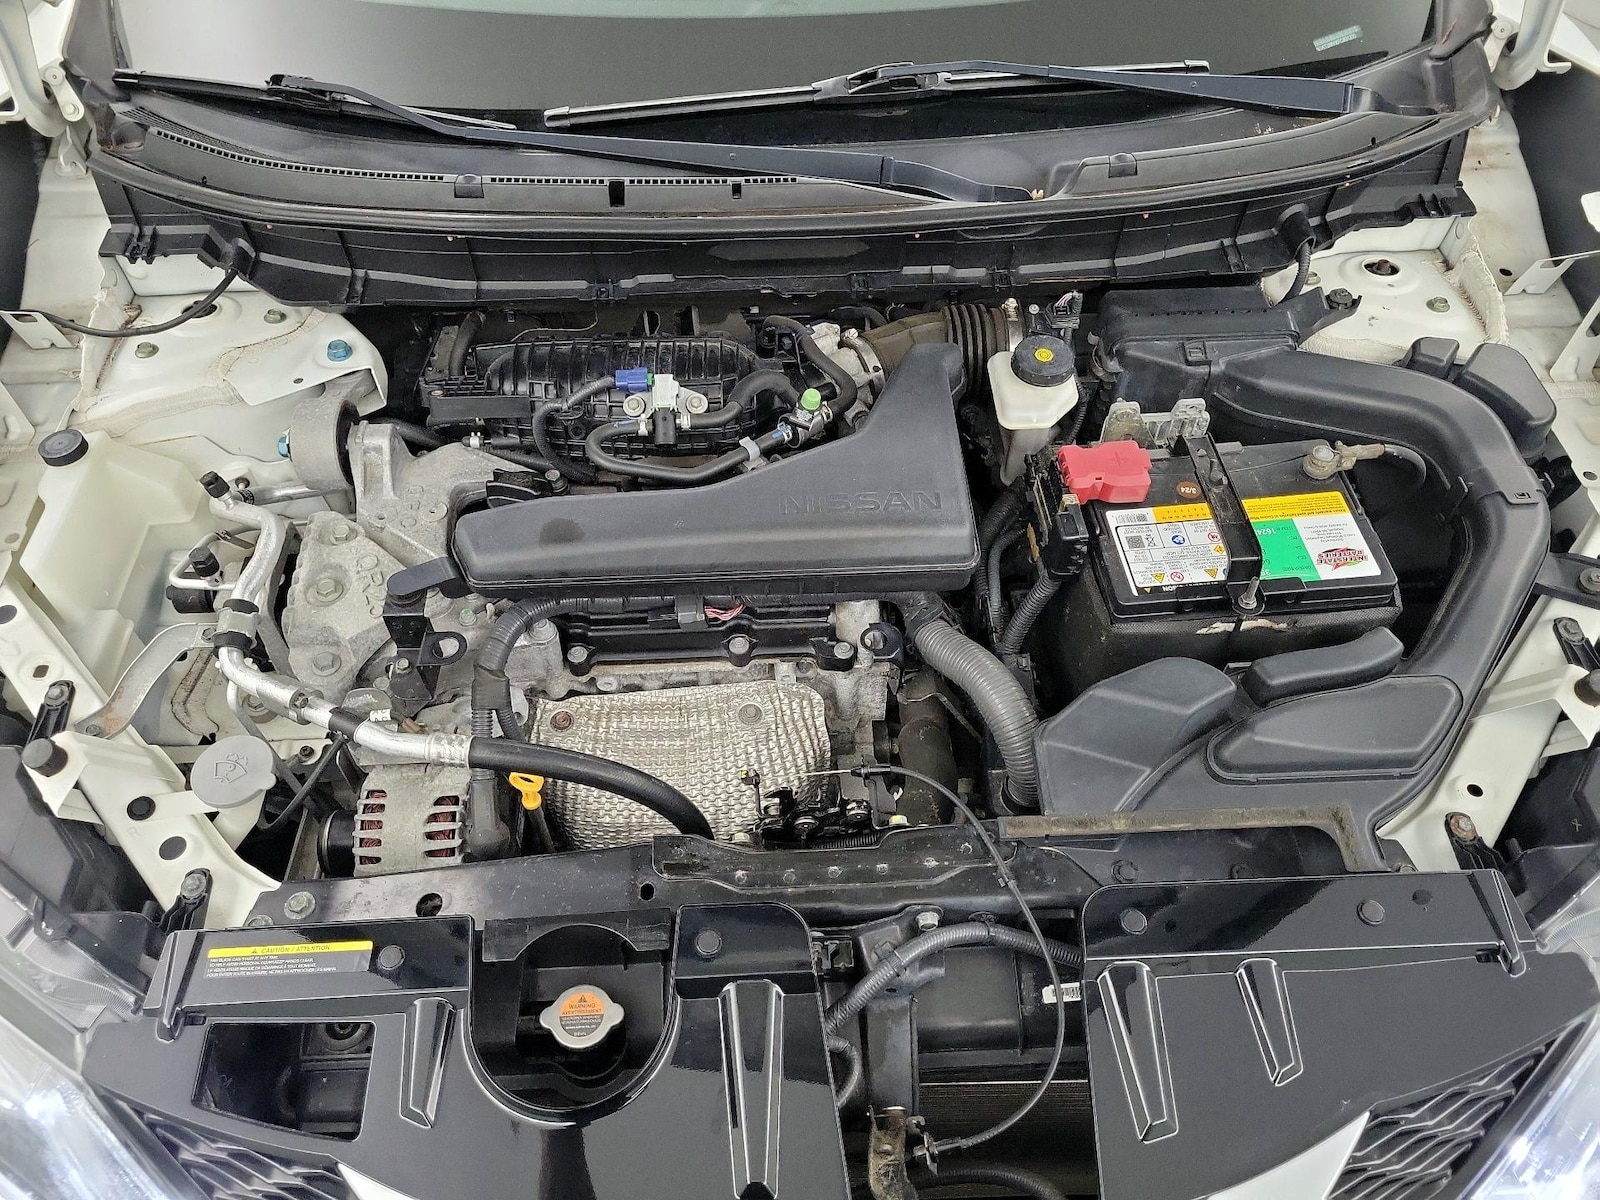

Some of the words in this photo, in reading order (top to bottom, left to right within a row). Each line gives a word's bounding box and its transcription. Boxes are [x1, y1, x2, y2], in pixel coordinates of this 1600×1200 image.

[1180, 486, 1197, 494] 3/24
[778, 490, 943, 514] NISSAN
[1317, 549, 1364, 559] BATTERIES
[1316, 555, 1368, 566] INTERSTATE
[296, 944, 331, 952] ATTENTION
